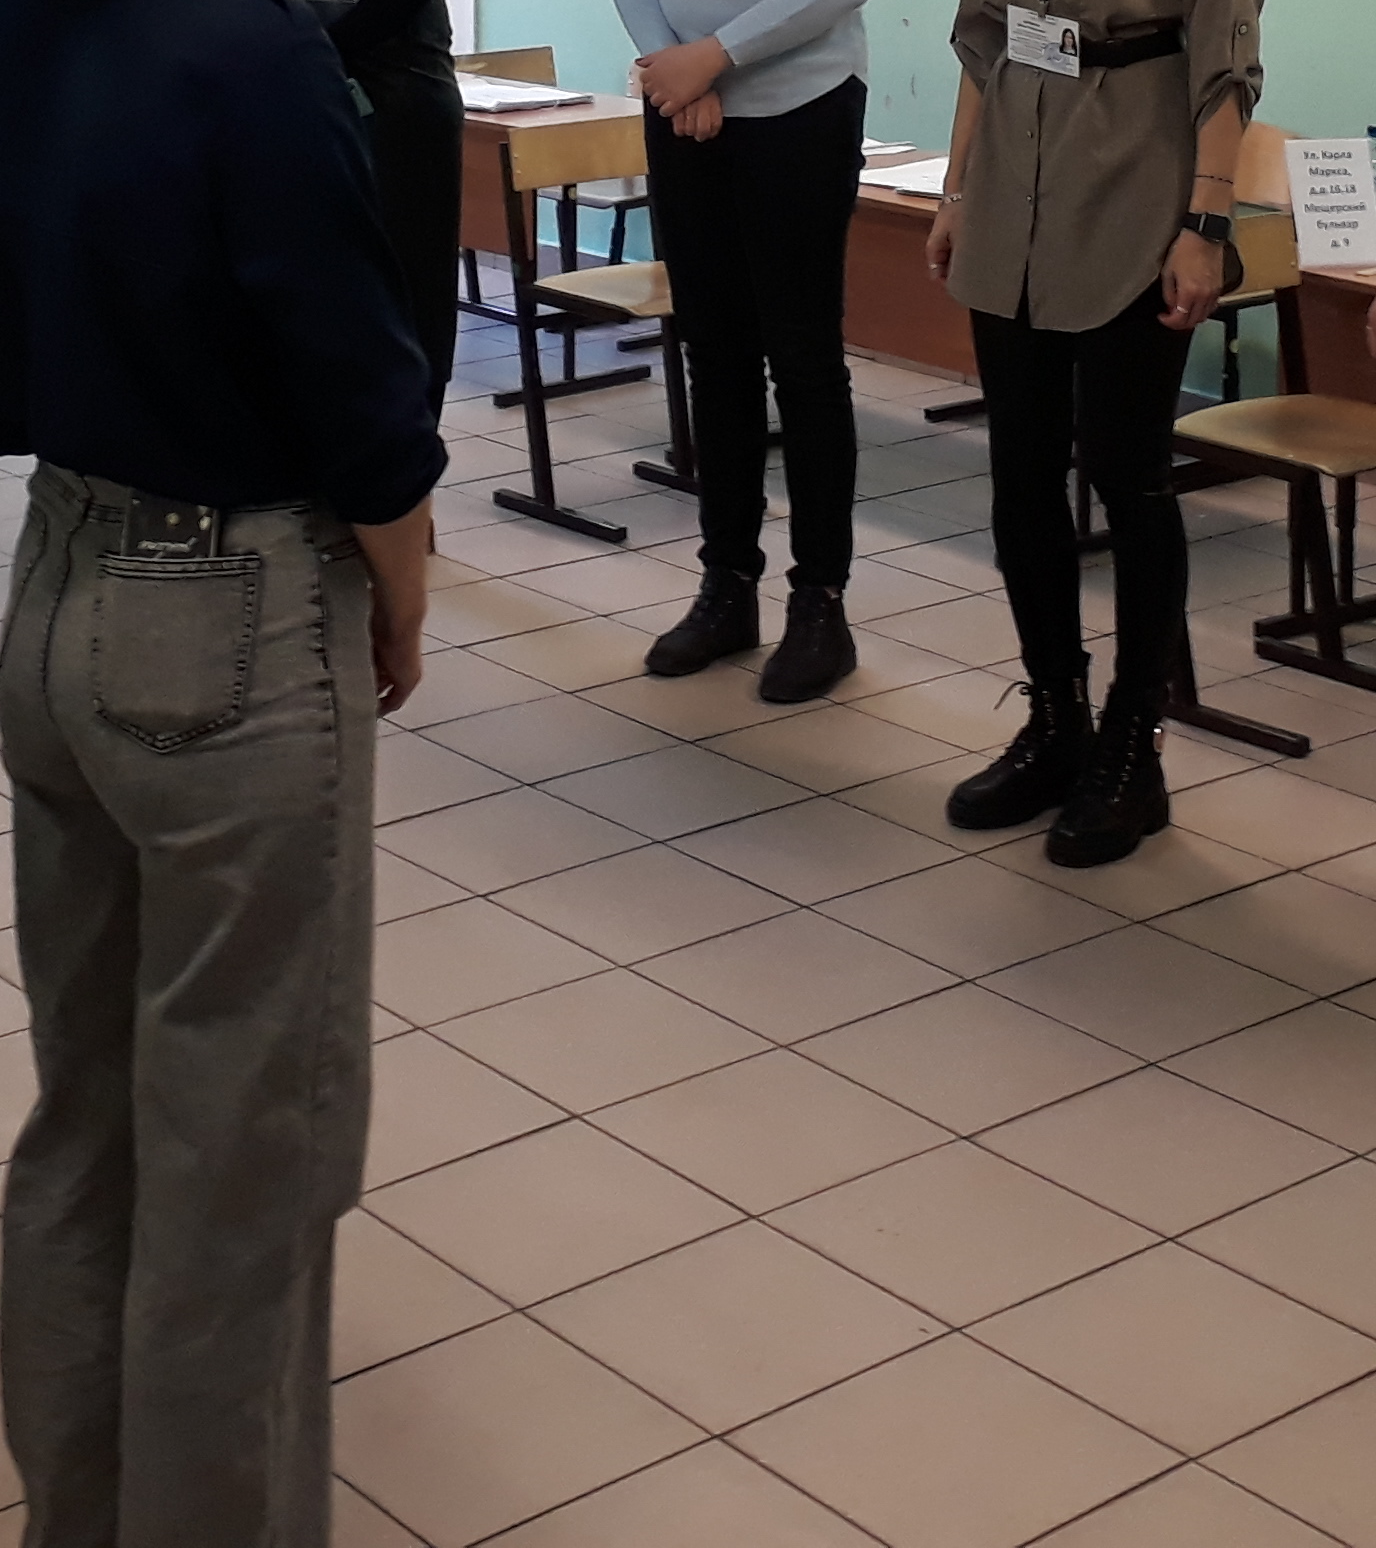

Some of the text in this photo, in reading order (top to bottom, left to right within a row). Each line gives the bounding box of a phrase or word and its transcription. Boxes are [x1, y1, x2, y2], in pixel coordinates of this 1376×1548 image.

[1322, 150, 1352, 159] Карла
[1304, 202, 1366, 213] Мещерский
[1317, 220, 1359, 229] бульвар
